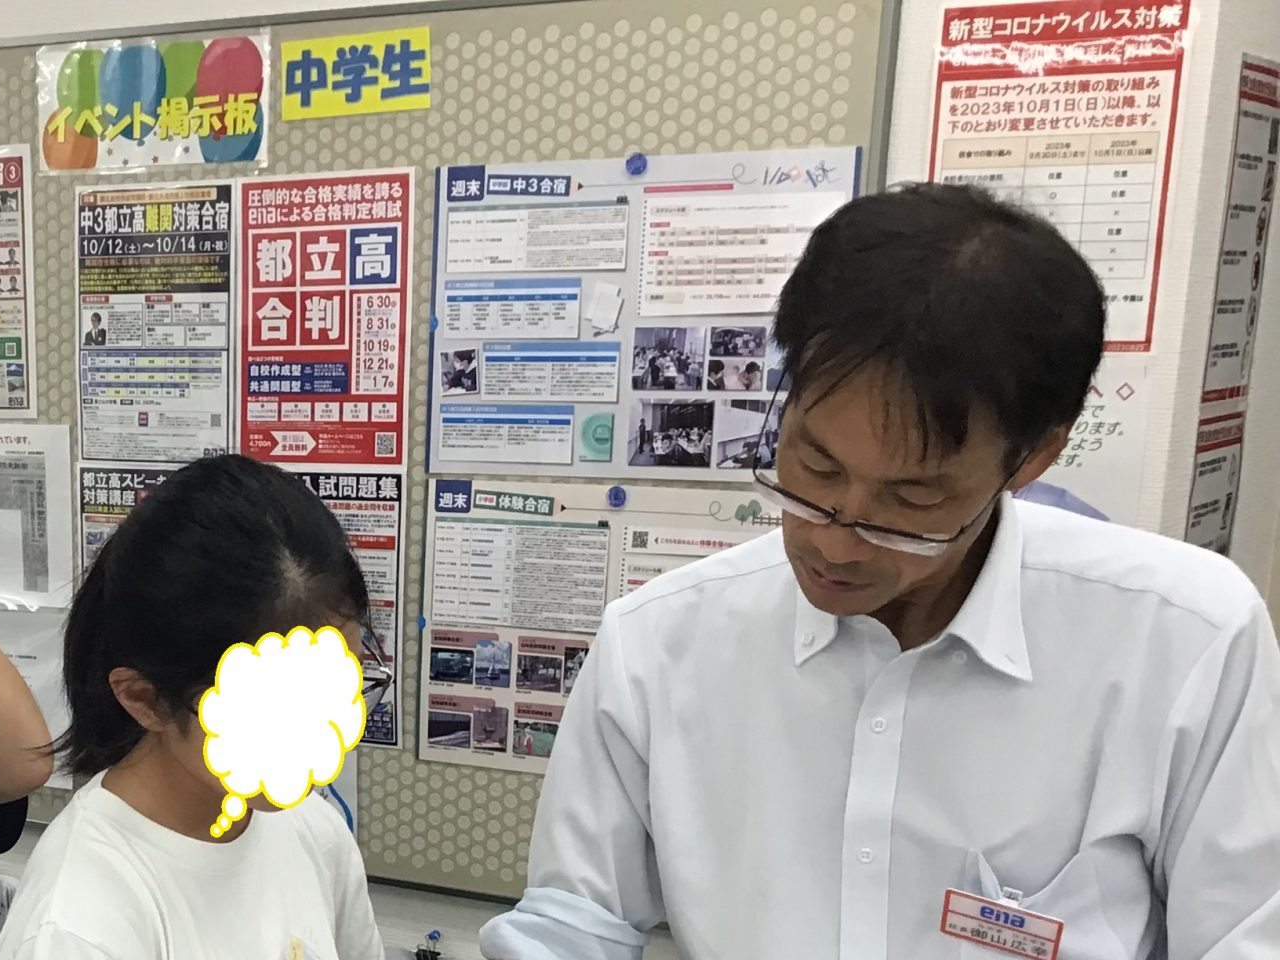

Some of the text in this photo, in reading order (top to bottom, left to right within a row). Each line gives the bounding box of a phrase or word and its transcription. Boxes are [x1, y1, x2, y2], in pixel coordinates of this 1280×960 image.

[949, 4, 1182, 41] 新型コロナウイルス対策
[285, 38, 430, 108] 中学生
[950, 77, 1160, 99] 新型コロナウイルス対策の取り組み
[47, 92, 259, 143] イベント掲示板
[947, 113, 1157, 133] 下のとおり変更させていただきます。
[248, 182, 402, 206] 圧倒的な合格実績を誇る
[451, 178, 567, 197] 週末 中3合宿
[80, 201, 229, 235] 中3都立高難関対策合宿
[248, 200, 402, 224] enaによる合格判定模試
[250, 365, 301, 377] 自校作成型
[250, 380, 301, 393] 共通問題型
[83, 489, 135, 506] 対策講座
[438, 492, 551, 514] 週末 体験合宿
[980, 905, 1026, 929] ena
